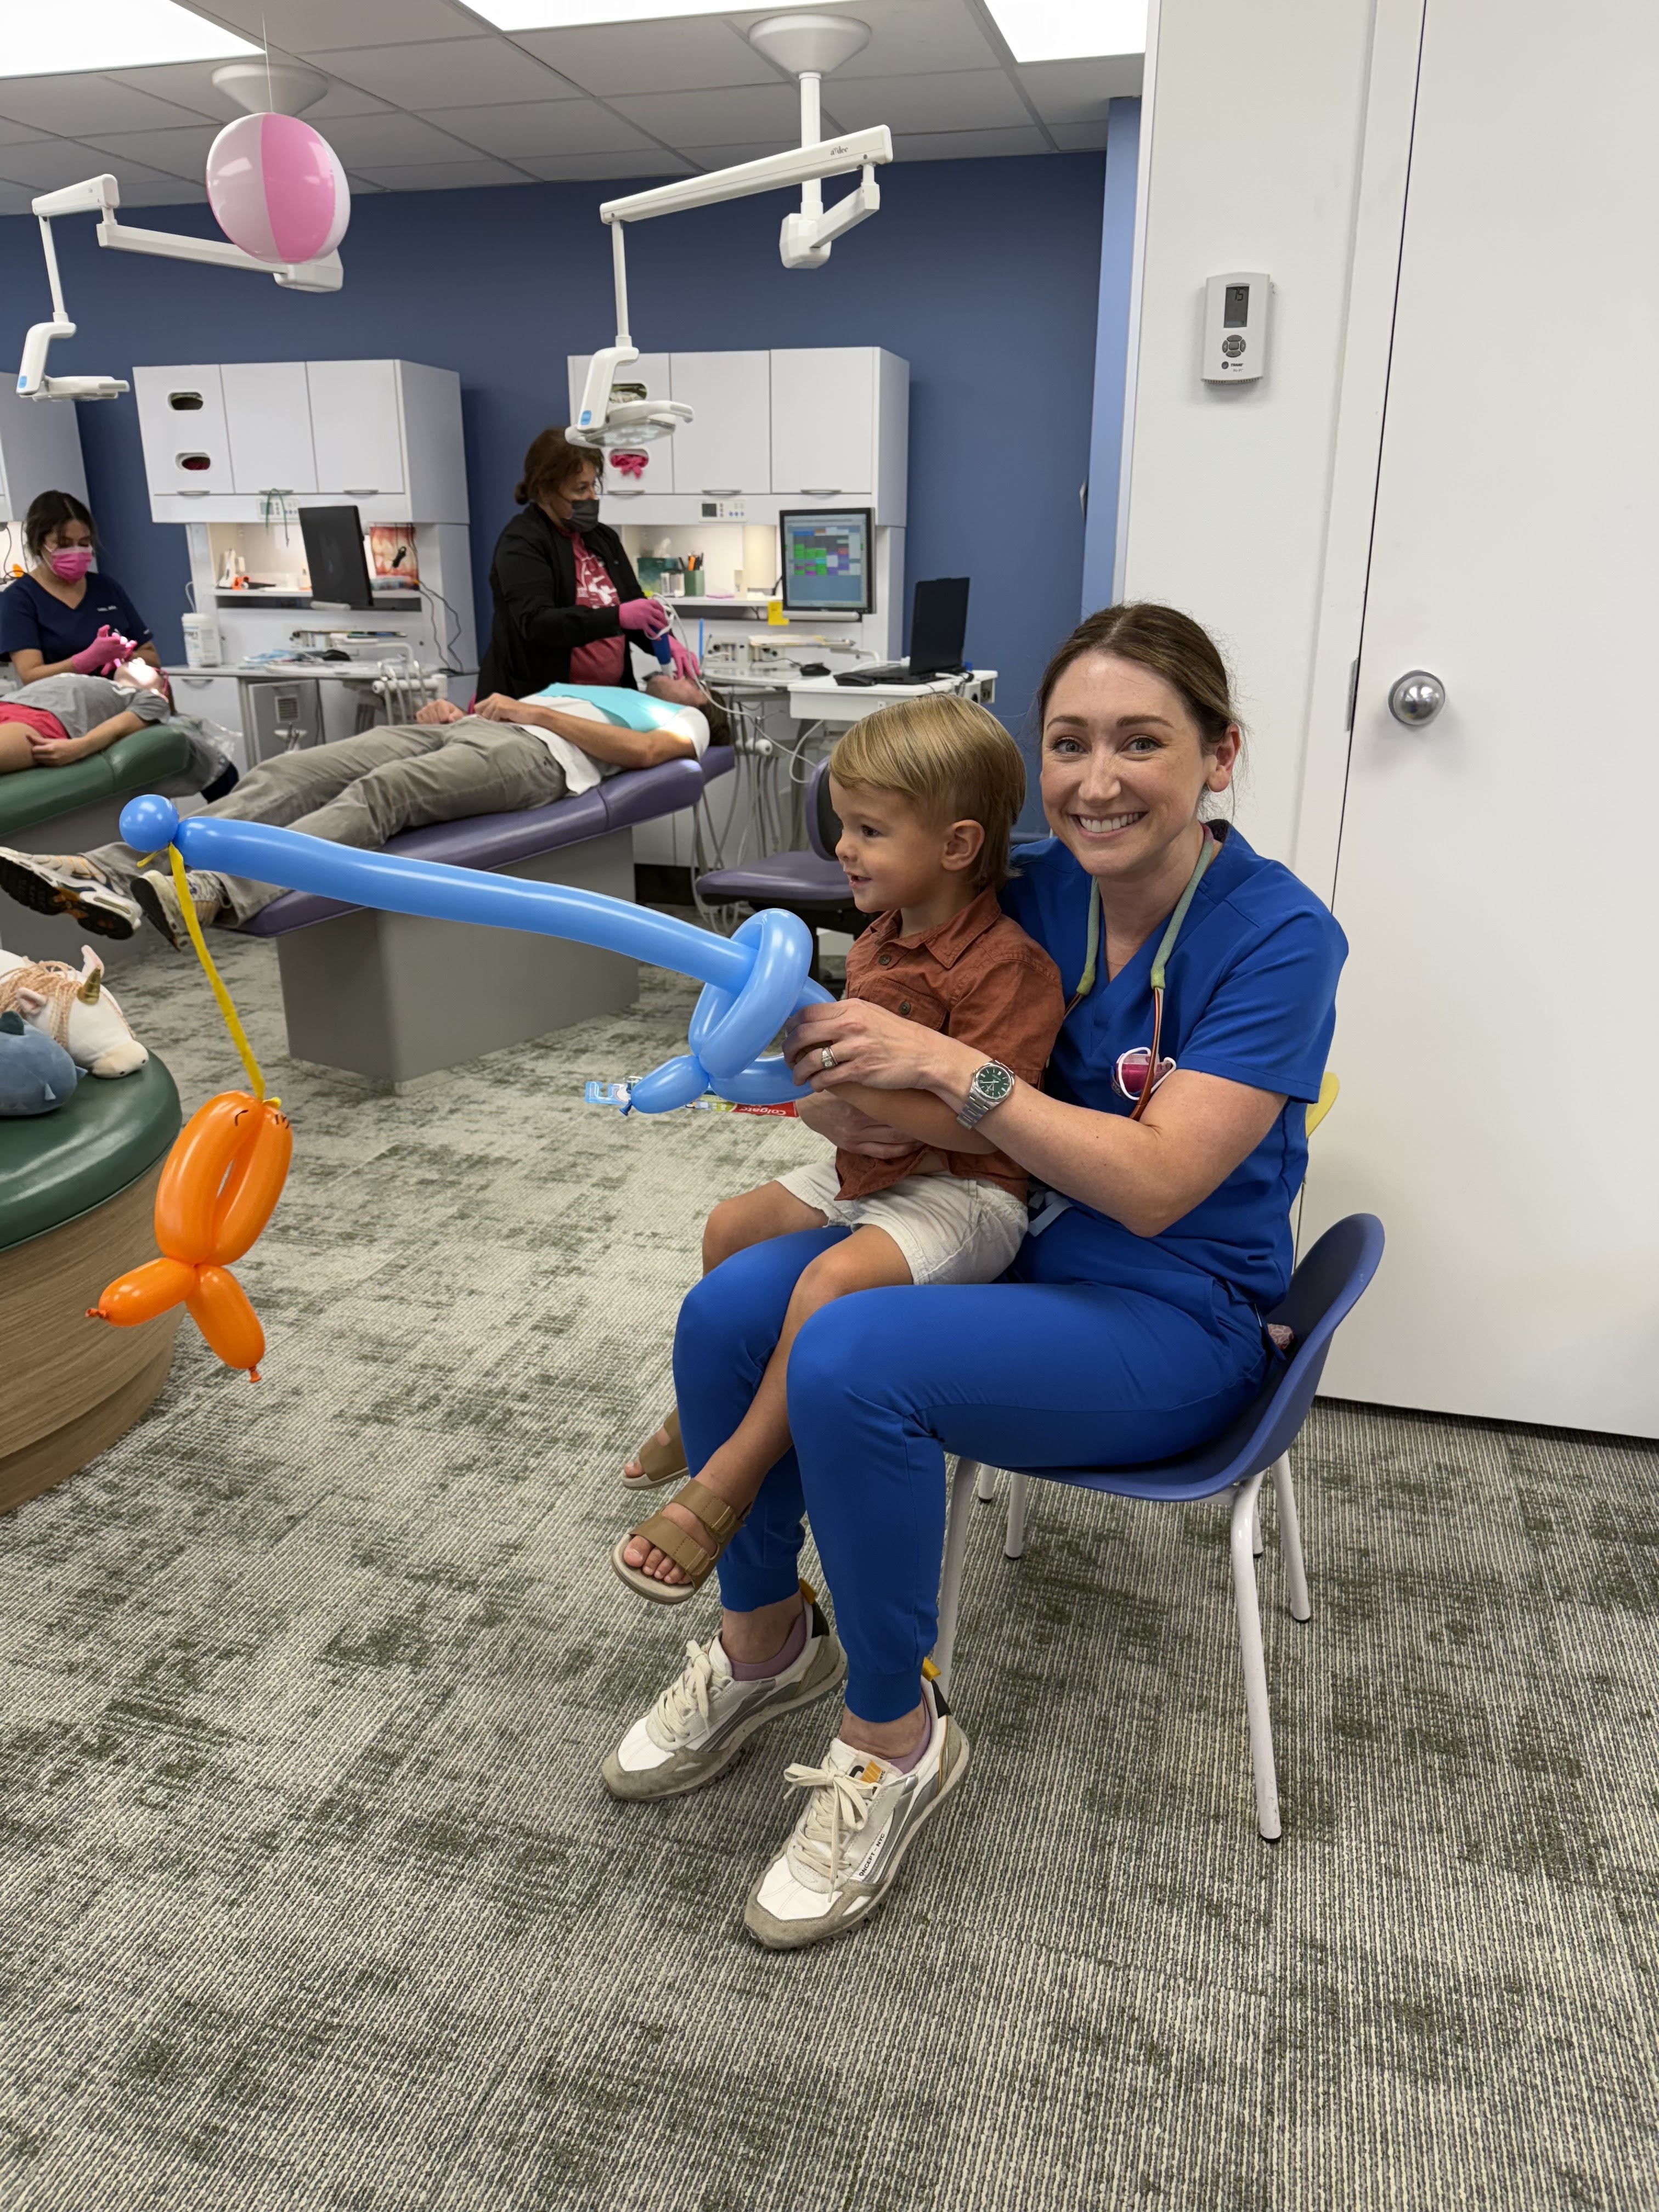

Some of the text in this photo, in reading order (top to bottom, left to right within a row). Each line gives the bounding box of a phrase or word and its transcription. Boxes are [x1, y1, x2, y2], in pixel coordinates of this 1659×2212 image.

[1233, 288, 1244, 301] 75
[740, 1106, 787, 1115] Colgate
[859, 1852, 875, 1876] ONCEPT
[876, 1833, 885, 1847] NYC
